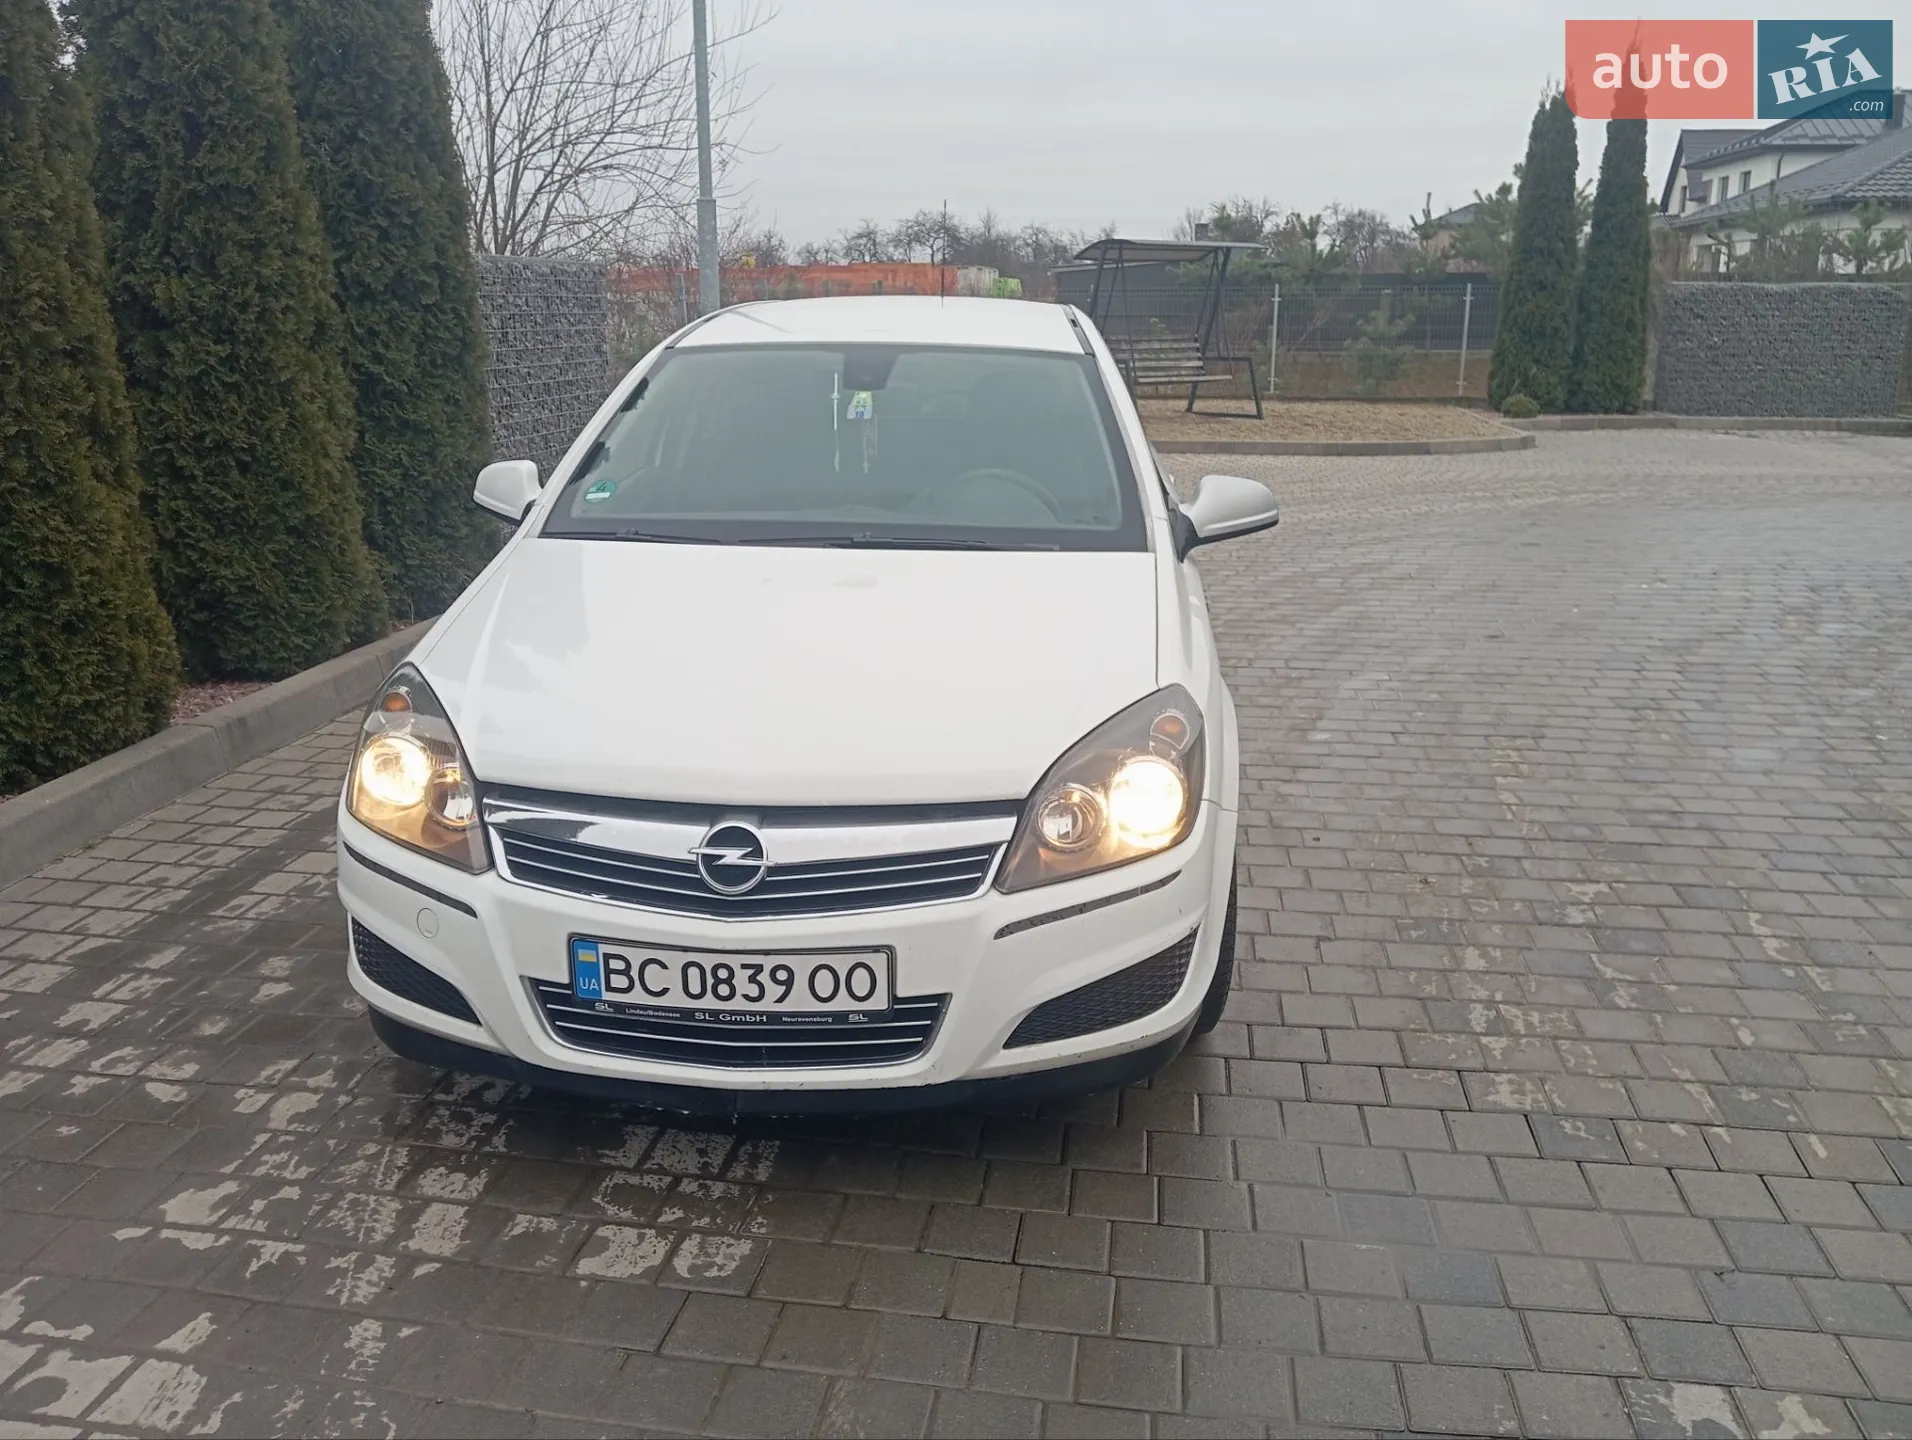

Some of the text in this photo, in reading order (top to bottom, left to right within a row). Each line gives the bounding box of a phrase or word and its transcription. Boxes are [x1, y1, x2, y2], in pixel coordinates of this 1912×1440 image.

[579, 976, 600, 991] UA
[602, 952, 877, 1004] BC 0839 OO
[594, 1002, 613, 1012] SL
[694, 1011, 767, 1023] SL GmbH
[848, 1013, 869, 1022] SL
